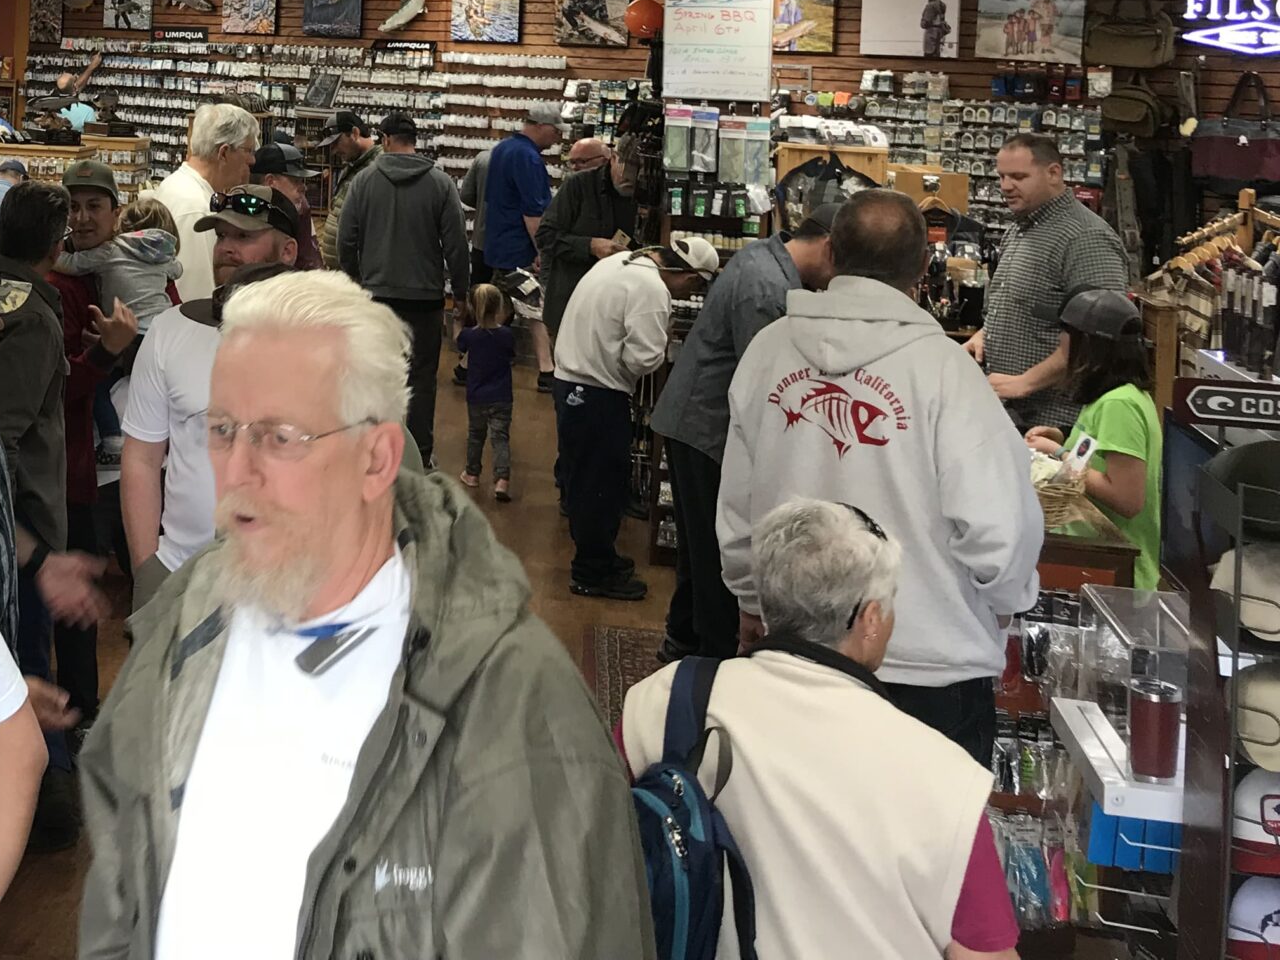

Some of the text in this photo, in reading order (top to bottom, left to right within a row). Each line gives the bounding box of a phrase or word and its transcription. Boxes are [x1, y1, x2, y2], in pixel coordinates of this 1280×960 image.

[719, 10, 757, 23] BBQ
[165, 31, 204, 40] UMPQUA
[386, 42, 430, 50] UMPQUA
[854, 367, 913, 431] California
[1241, 397, 1280, 417] CO
